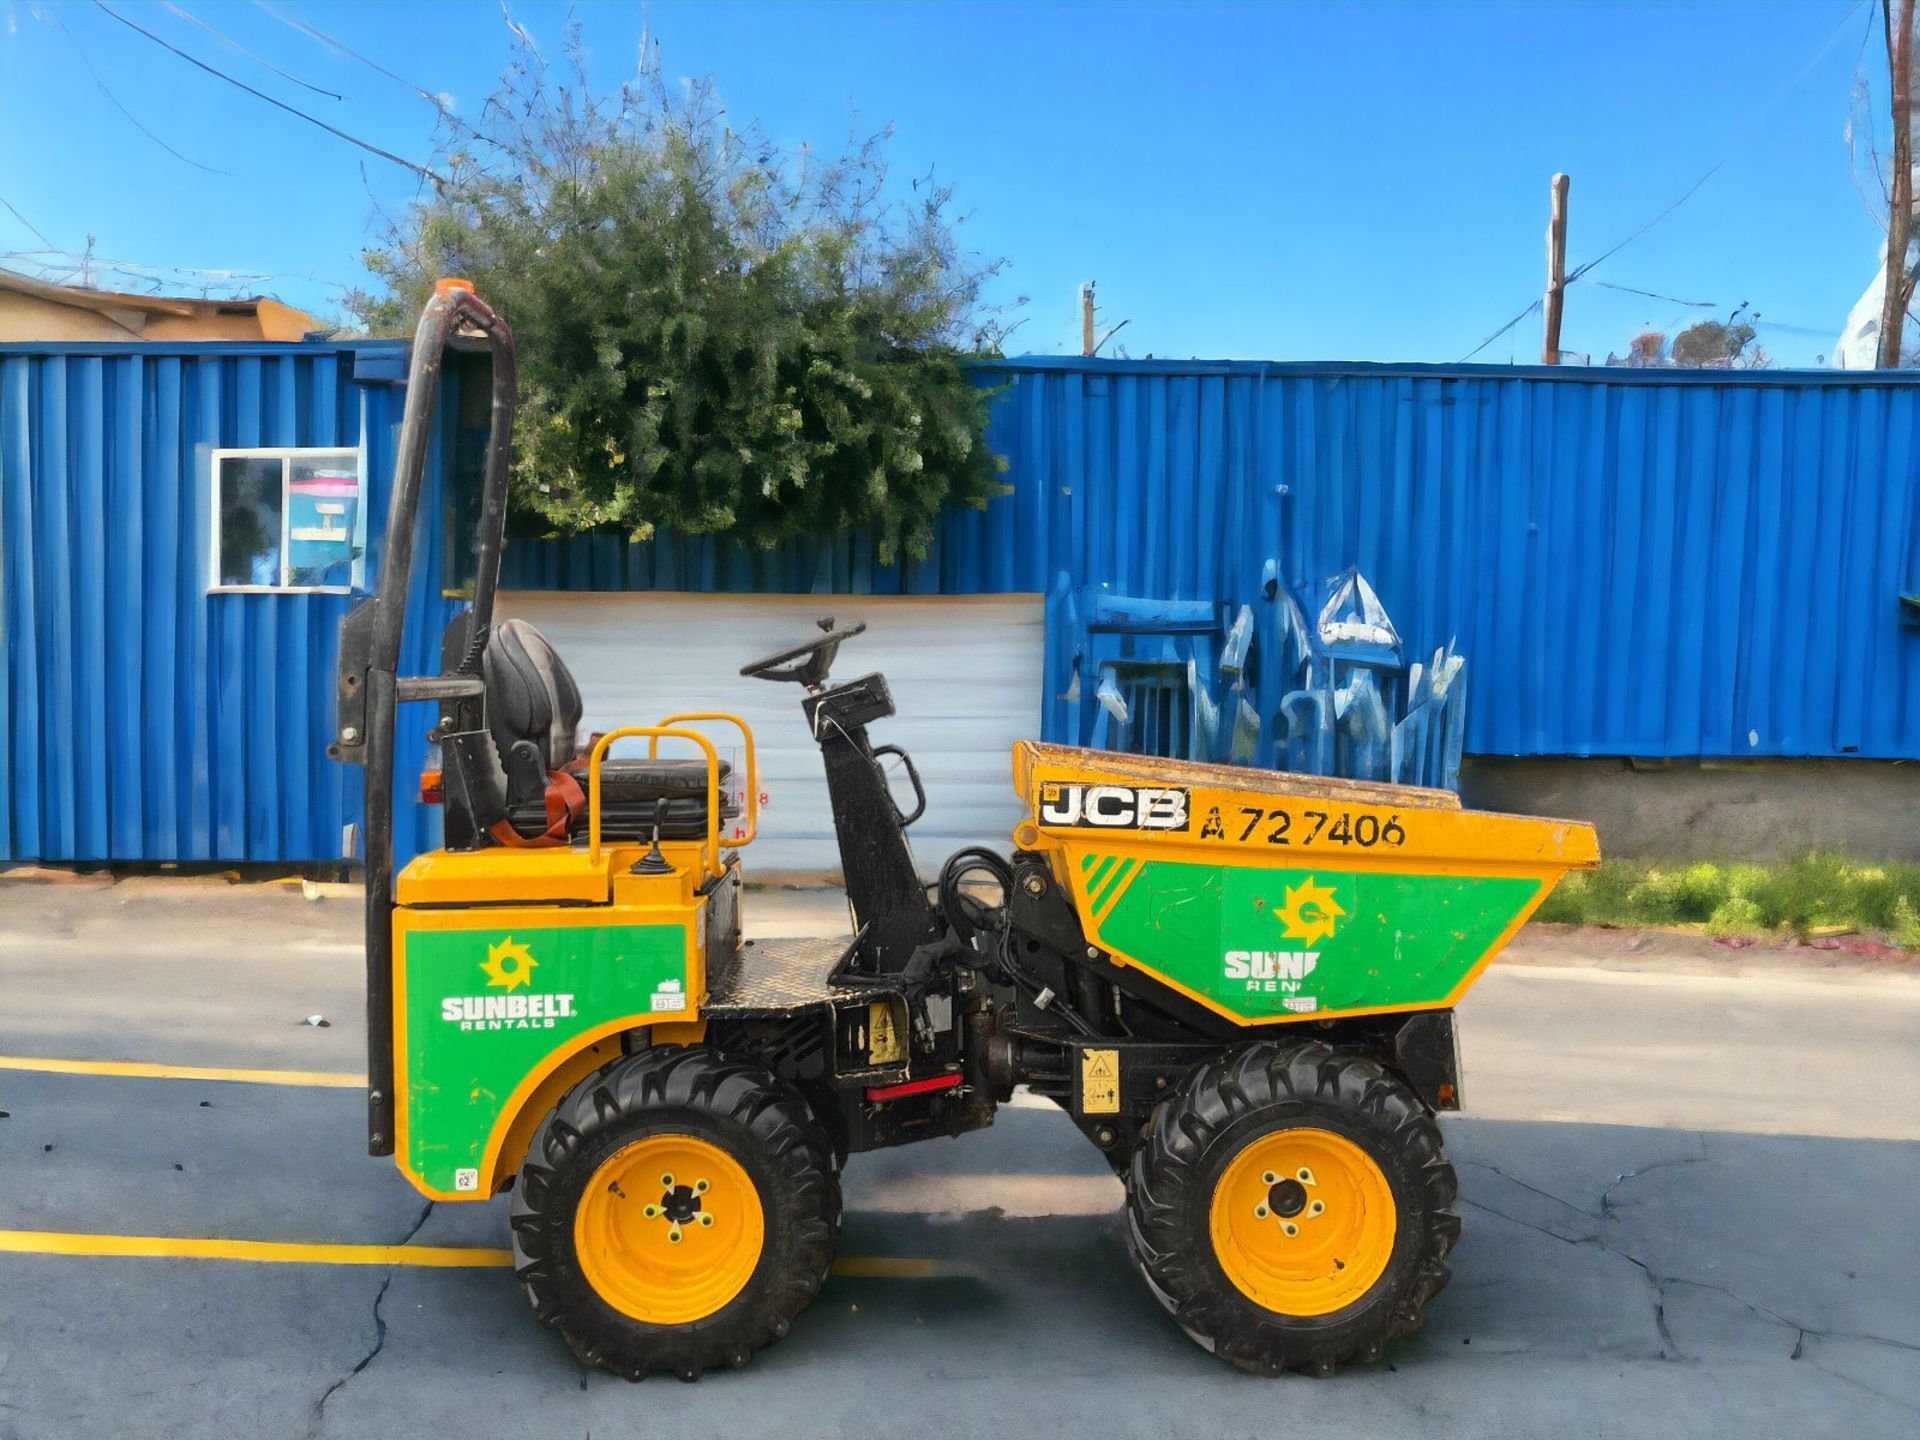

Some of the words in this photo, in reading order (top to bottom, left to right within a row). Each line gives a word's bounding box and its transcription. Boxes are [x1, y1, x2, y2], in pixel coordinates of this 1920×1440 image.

[1043, 785, 1188, 827] JCB
[1246, 980, 1302, 992] REN
[441, 993, 575, 1021] SUNBELT
[460, 1018, 556, 1031] RENTALS
